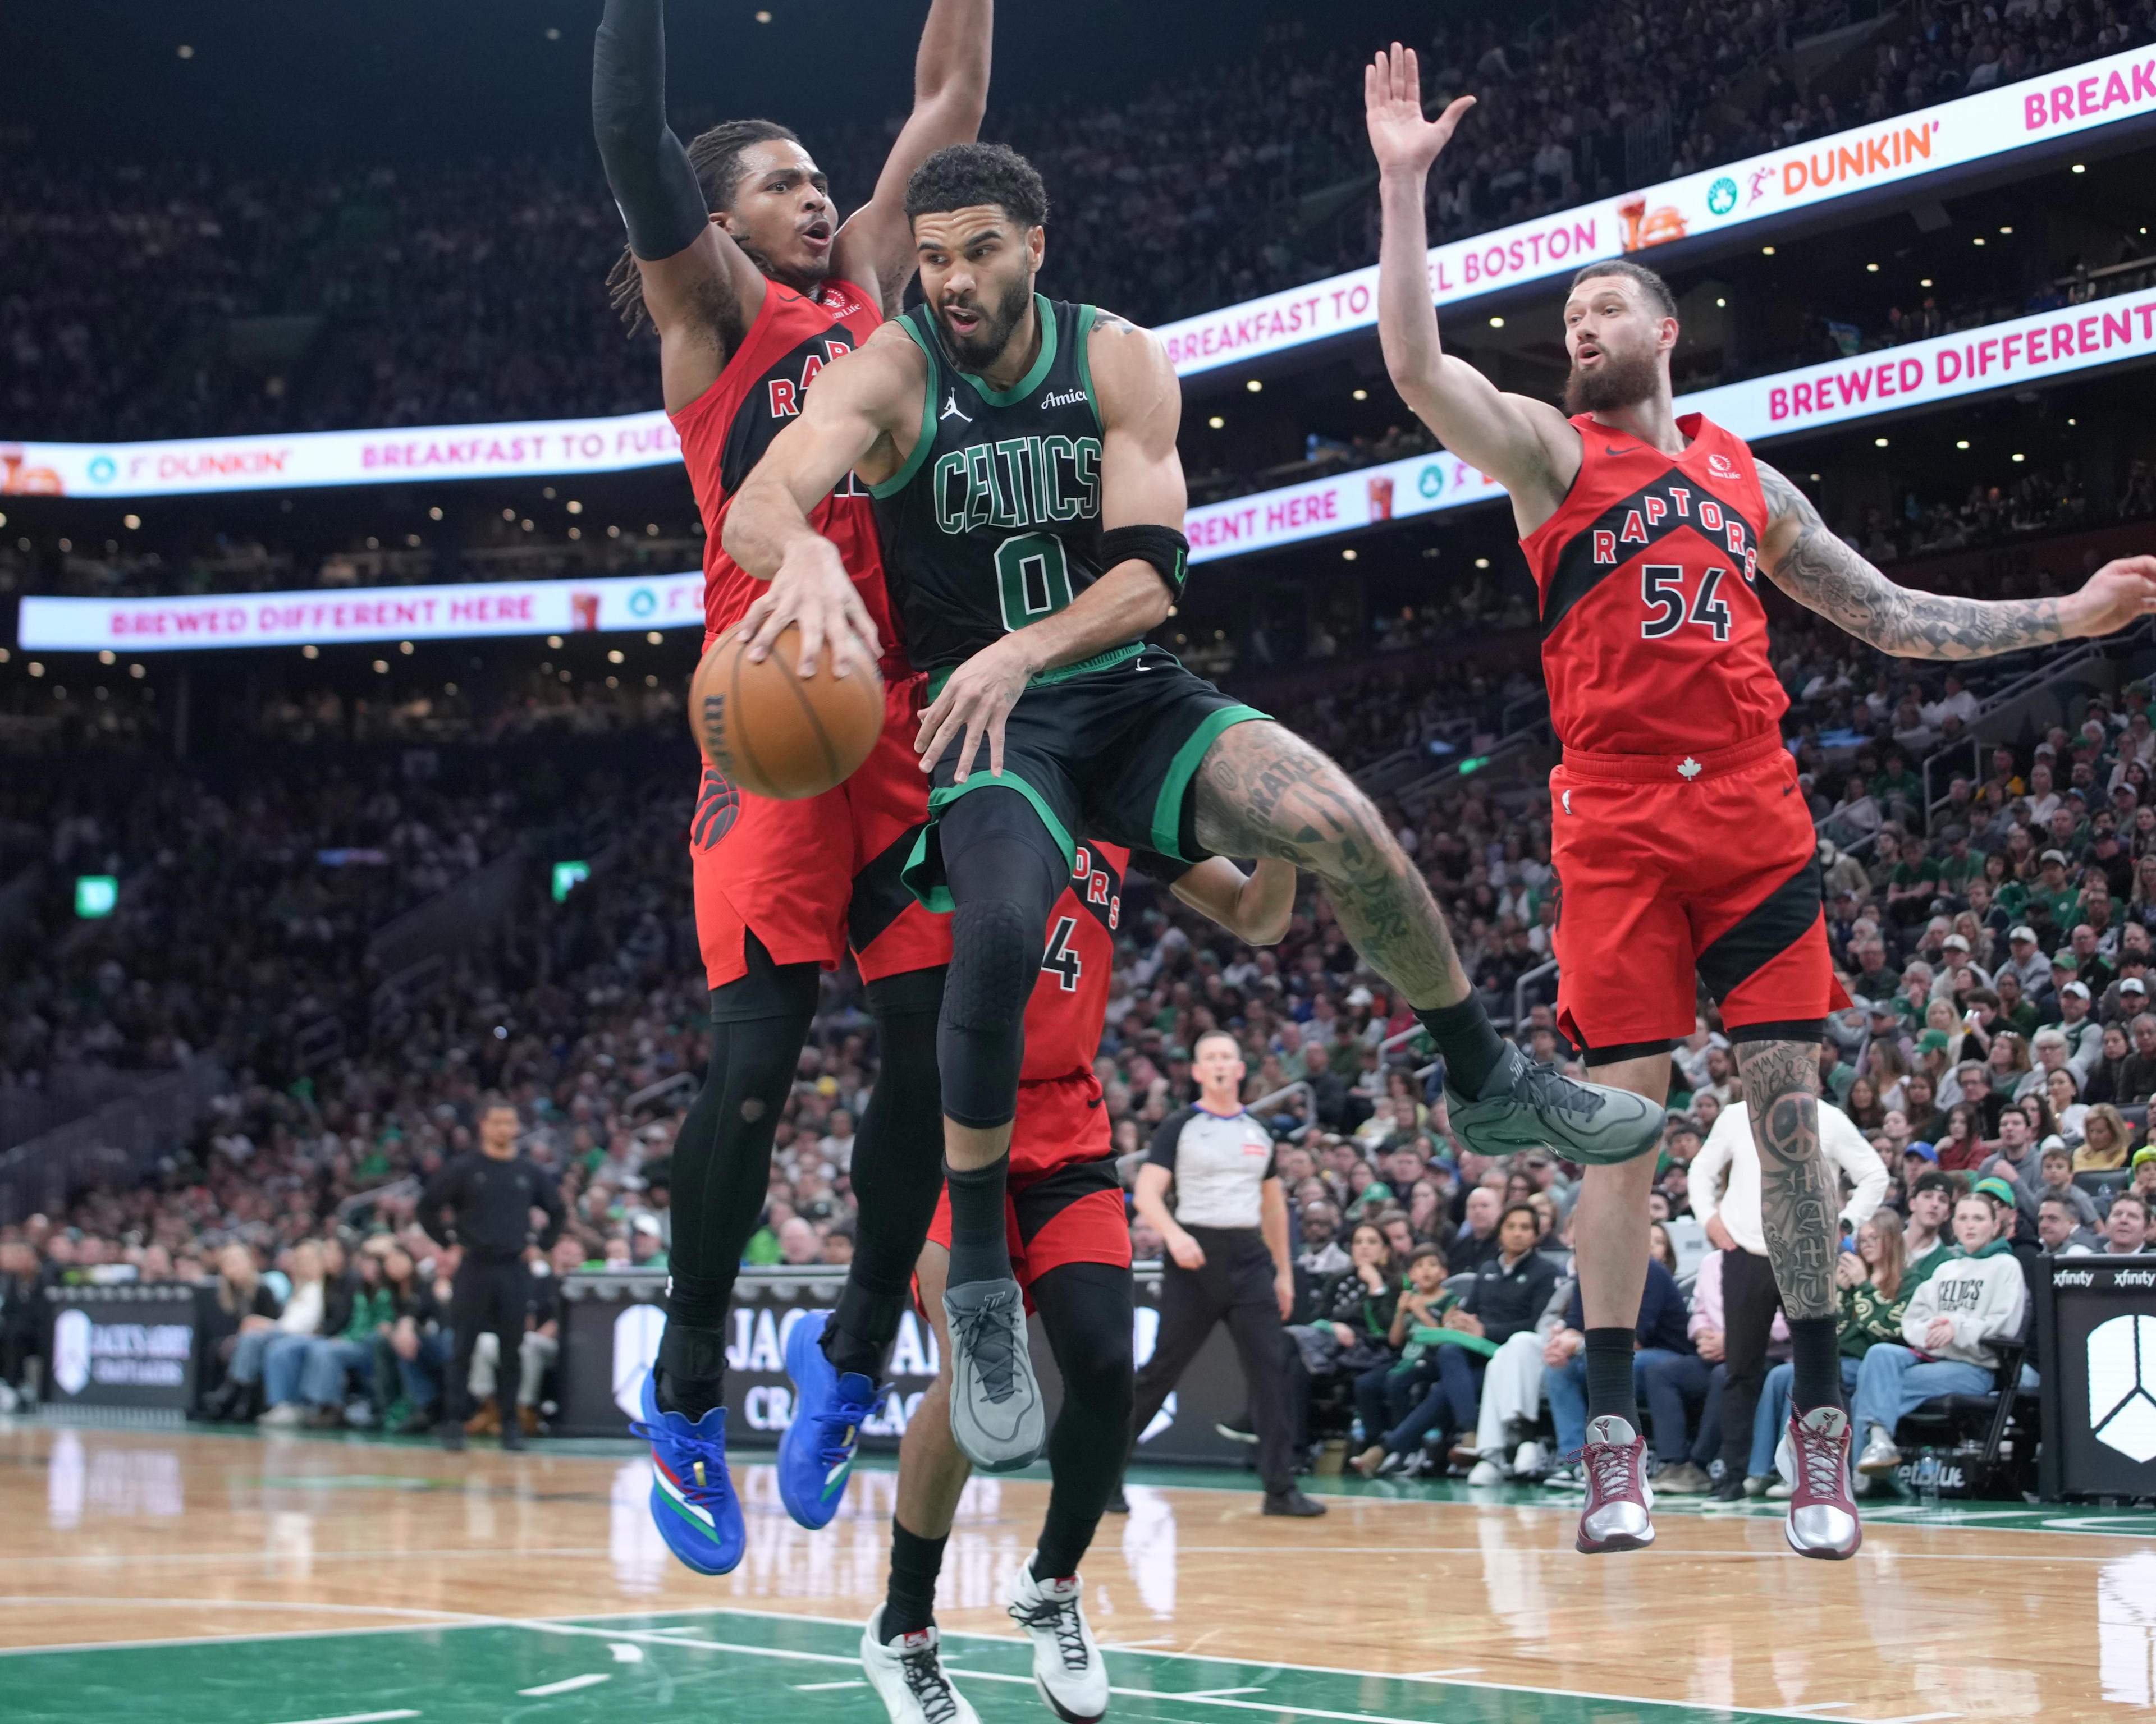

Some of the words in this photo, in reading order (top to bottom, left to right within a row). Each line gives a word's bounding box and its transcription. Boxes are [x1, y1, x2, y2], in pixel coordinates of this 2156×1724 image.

[1783, 120, 1939, 196] DUNKIN'
[1167, 297, 1320, 364] BREAKFAST
[1331, 285, 1370, 318] TO
[1464, 219, 1596, 283] BOSTON
[768, 340, 852, 418] RAP
[1770, 358, 1924, 421] BREWED
[1937, 302, 2156, 384] DIFFERENT
[361, 437, 544, 468] BREAKFAST
[562, 434, 603, 458] TO
[933, 435, 1104, 535] CELTICS
[1266, 490, 1338, 532] HERE
[1593, 487, 1756, 582] RAPTORS
[111, 608, 247, 636] BREWED
[259, 599, 438, 632] DIFFERENT
[450, 594, 533, 623] HERE
[993, 531, 1074, 634] 0
[1641, 564, 1732, 641] 54
[1072, 846, 1120, 930] ORS
[1041, 915, 1082, 992] 4
[2053, 1269, 2095, 1288] xfinity
[2113, 1268, 2156, 1288] xfinity
